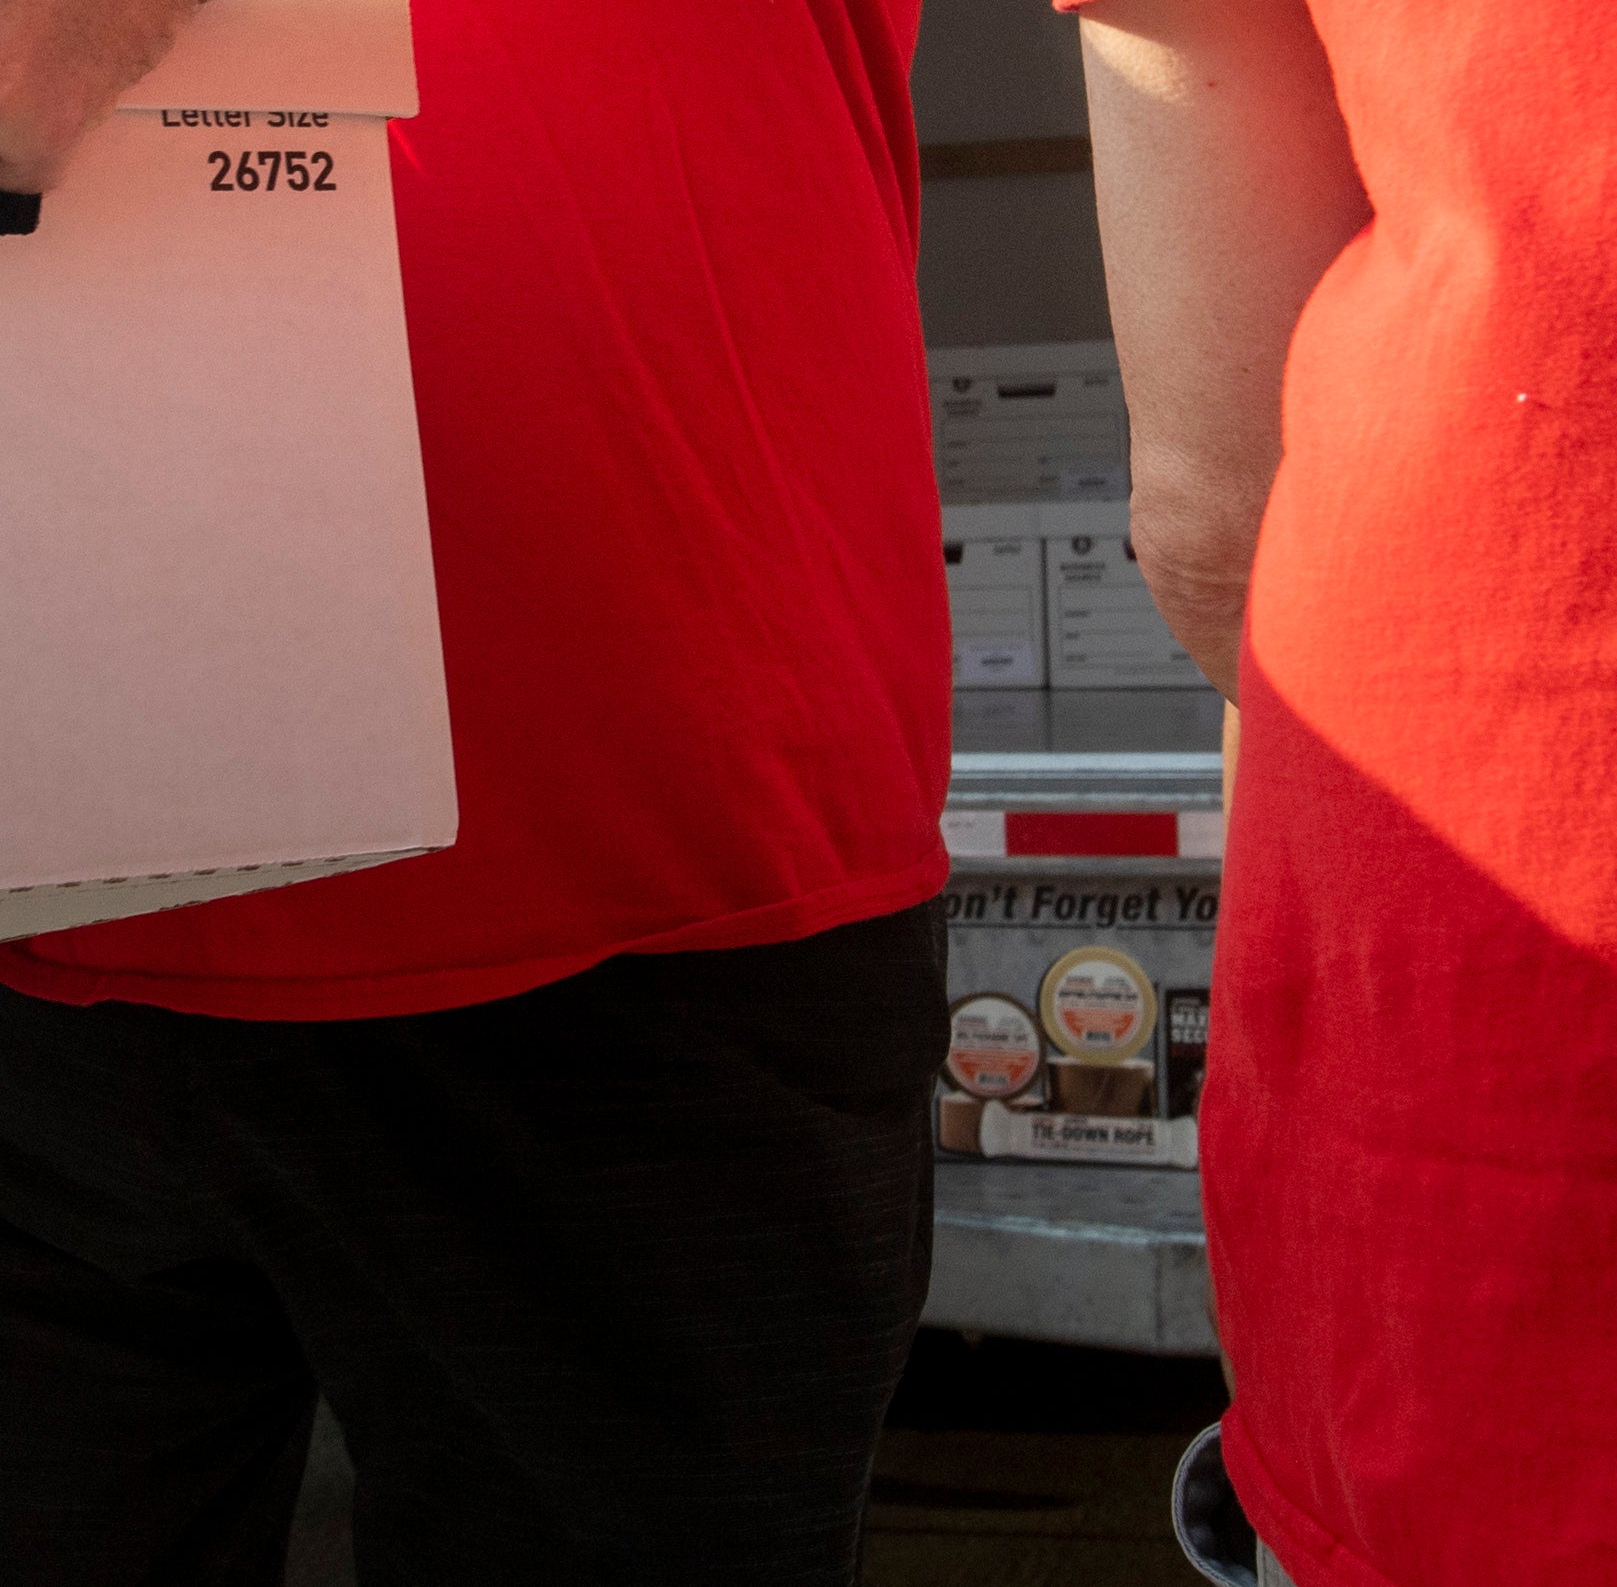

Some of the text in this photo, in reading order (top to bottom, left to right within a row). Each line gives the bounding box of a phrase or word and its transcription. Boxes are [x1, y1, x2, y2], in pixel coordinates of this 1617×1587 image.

[207, 151, 337, 192] 26752
[945, 885, 1218, 928] on't Forget Yo
